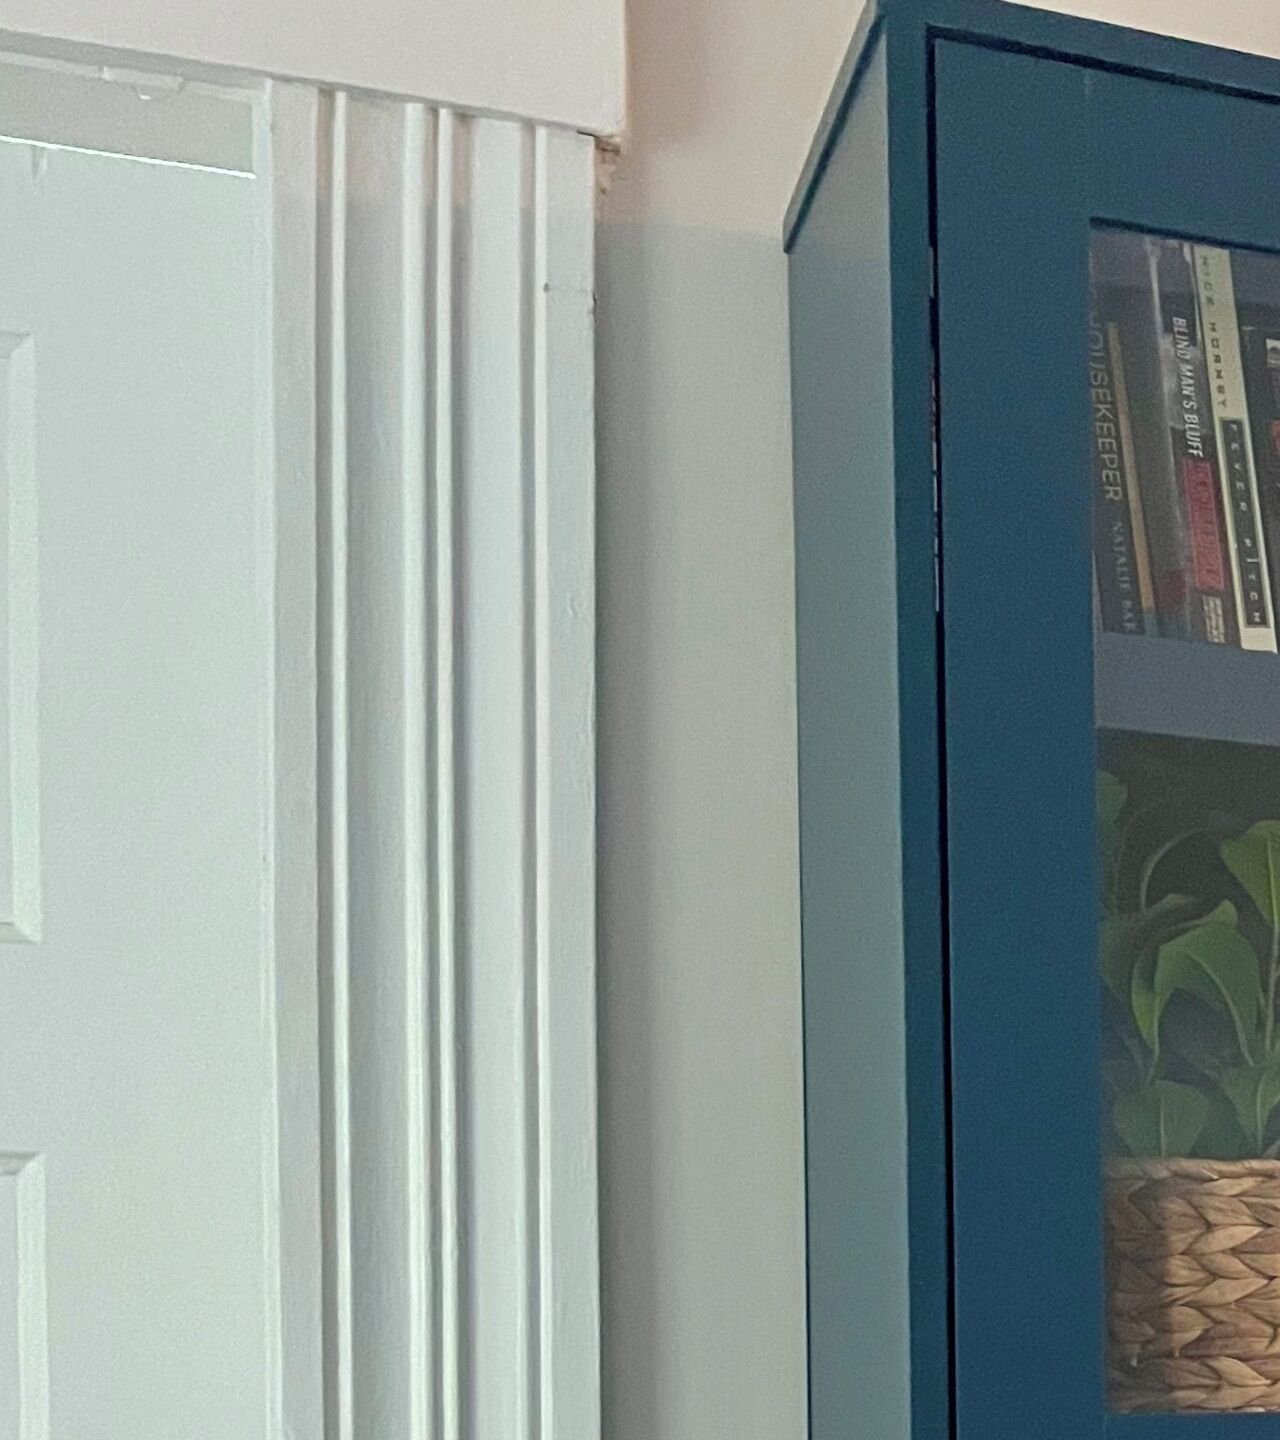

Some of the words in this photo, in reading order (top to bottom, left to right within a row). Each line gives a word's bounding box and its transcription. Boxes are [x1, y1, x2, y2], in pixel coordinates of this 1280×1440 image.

[1172, 316, 1191, 360] BLIND
[1179, 363, 1197, 409] MAN'S
[1184, 413, 1204, 458] BLUFF
[1229, 422, 1248, 512] FEVER
[1244, 537, 1261, 624] PITCH
